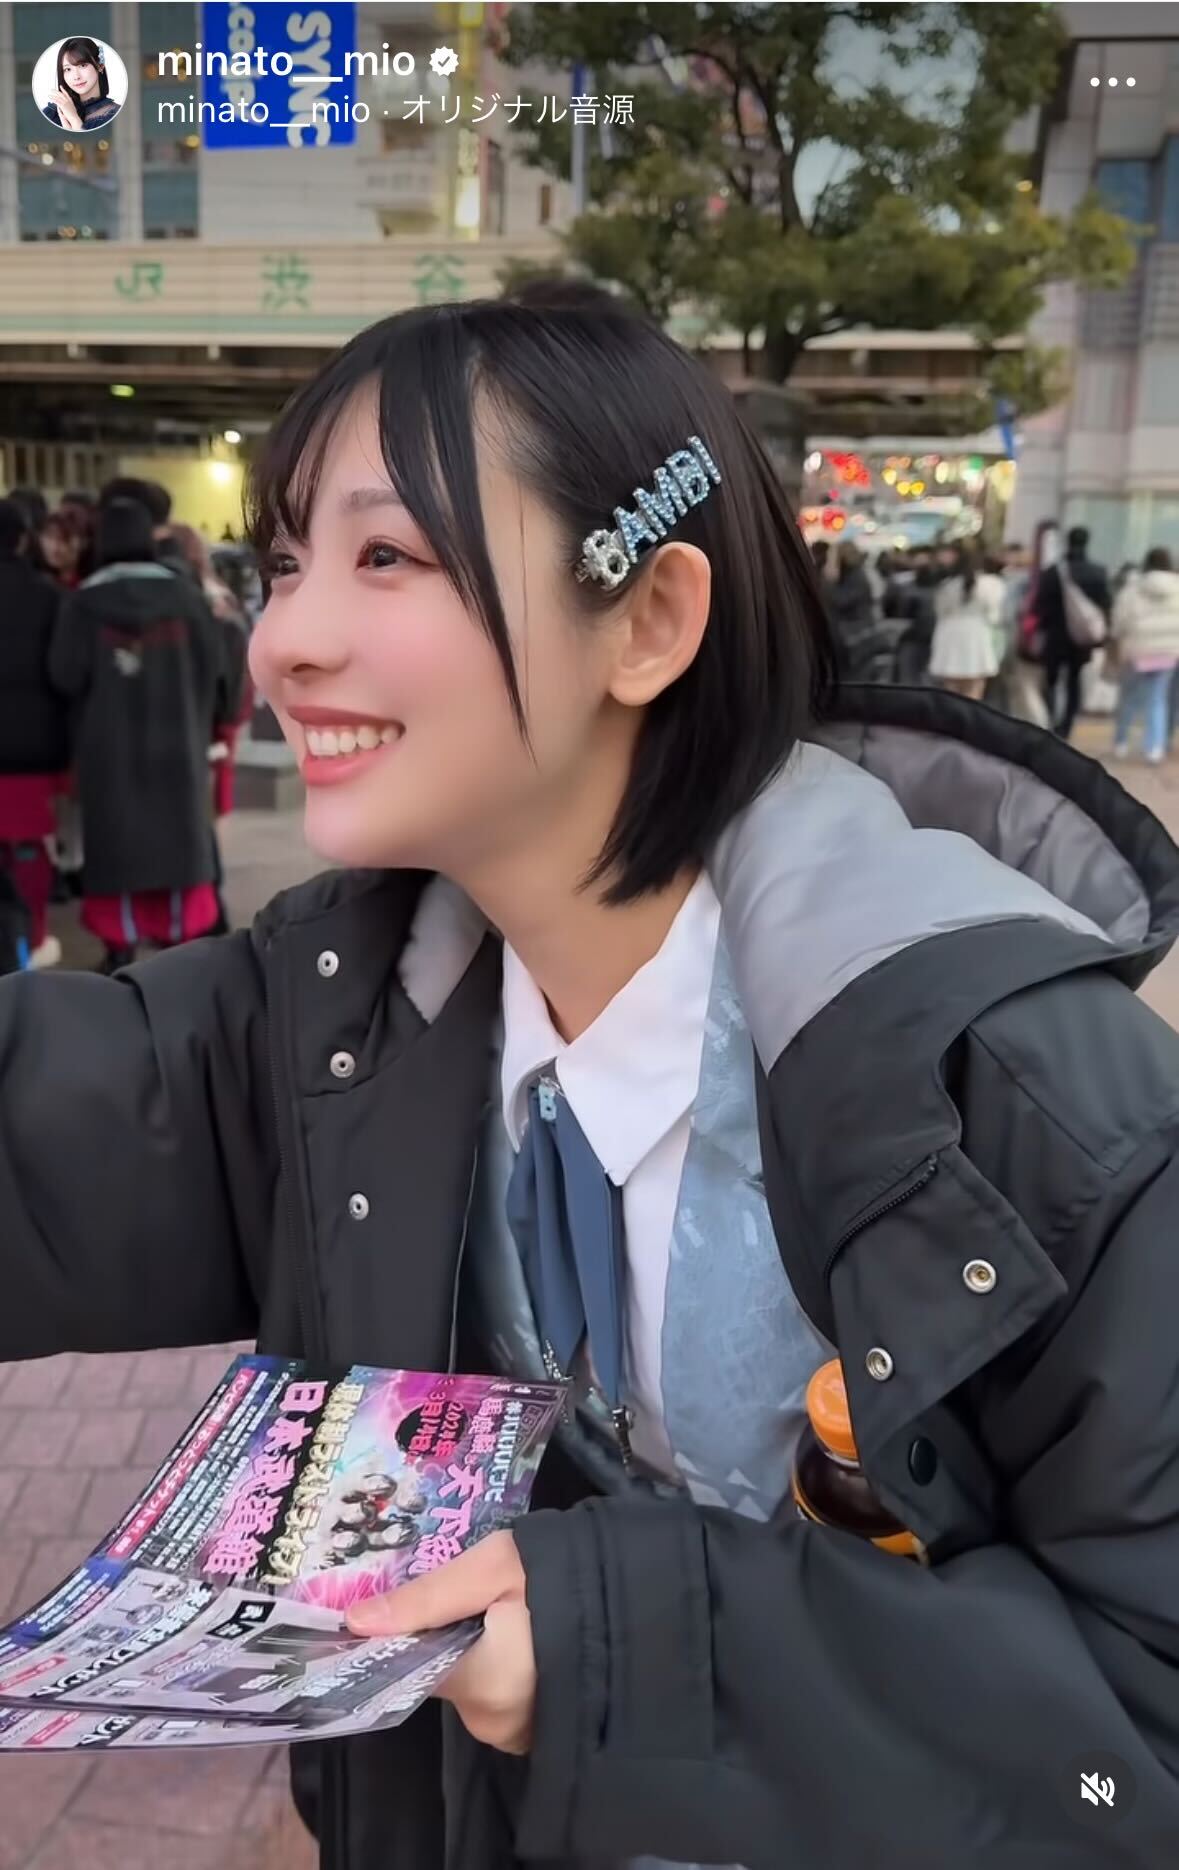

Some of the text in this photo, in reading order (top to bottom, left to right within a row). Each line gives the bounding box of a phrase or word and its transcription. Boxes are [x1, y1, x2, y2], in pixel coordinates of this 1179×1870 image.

[286, 10, 332, 149] SYNC
[114, 260, 165, 299] JR
[202, 1380, 329, 1575] 日本武道館
